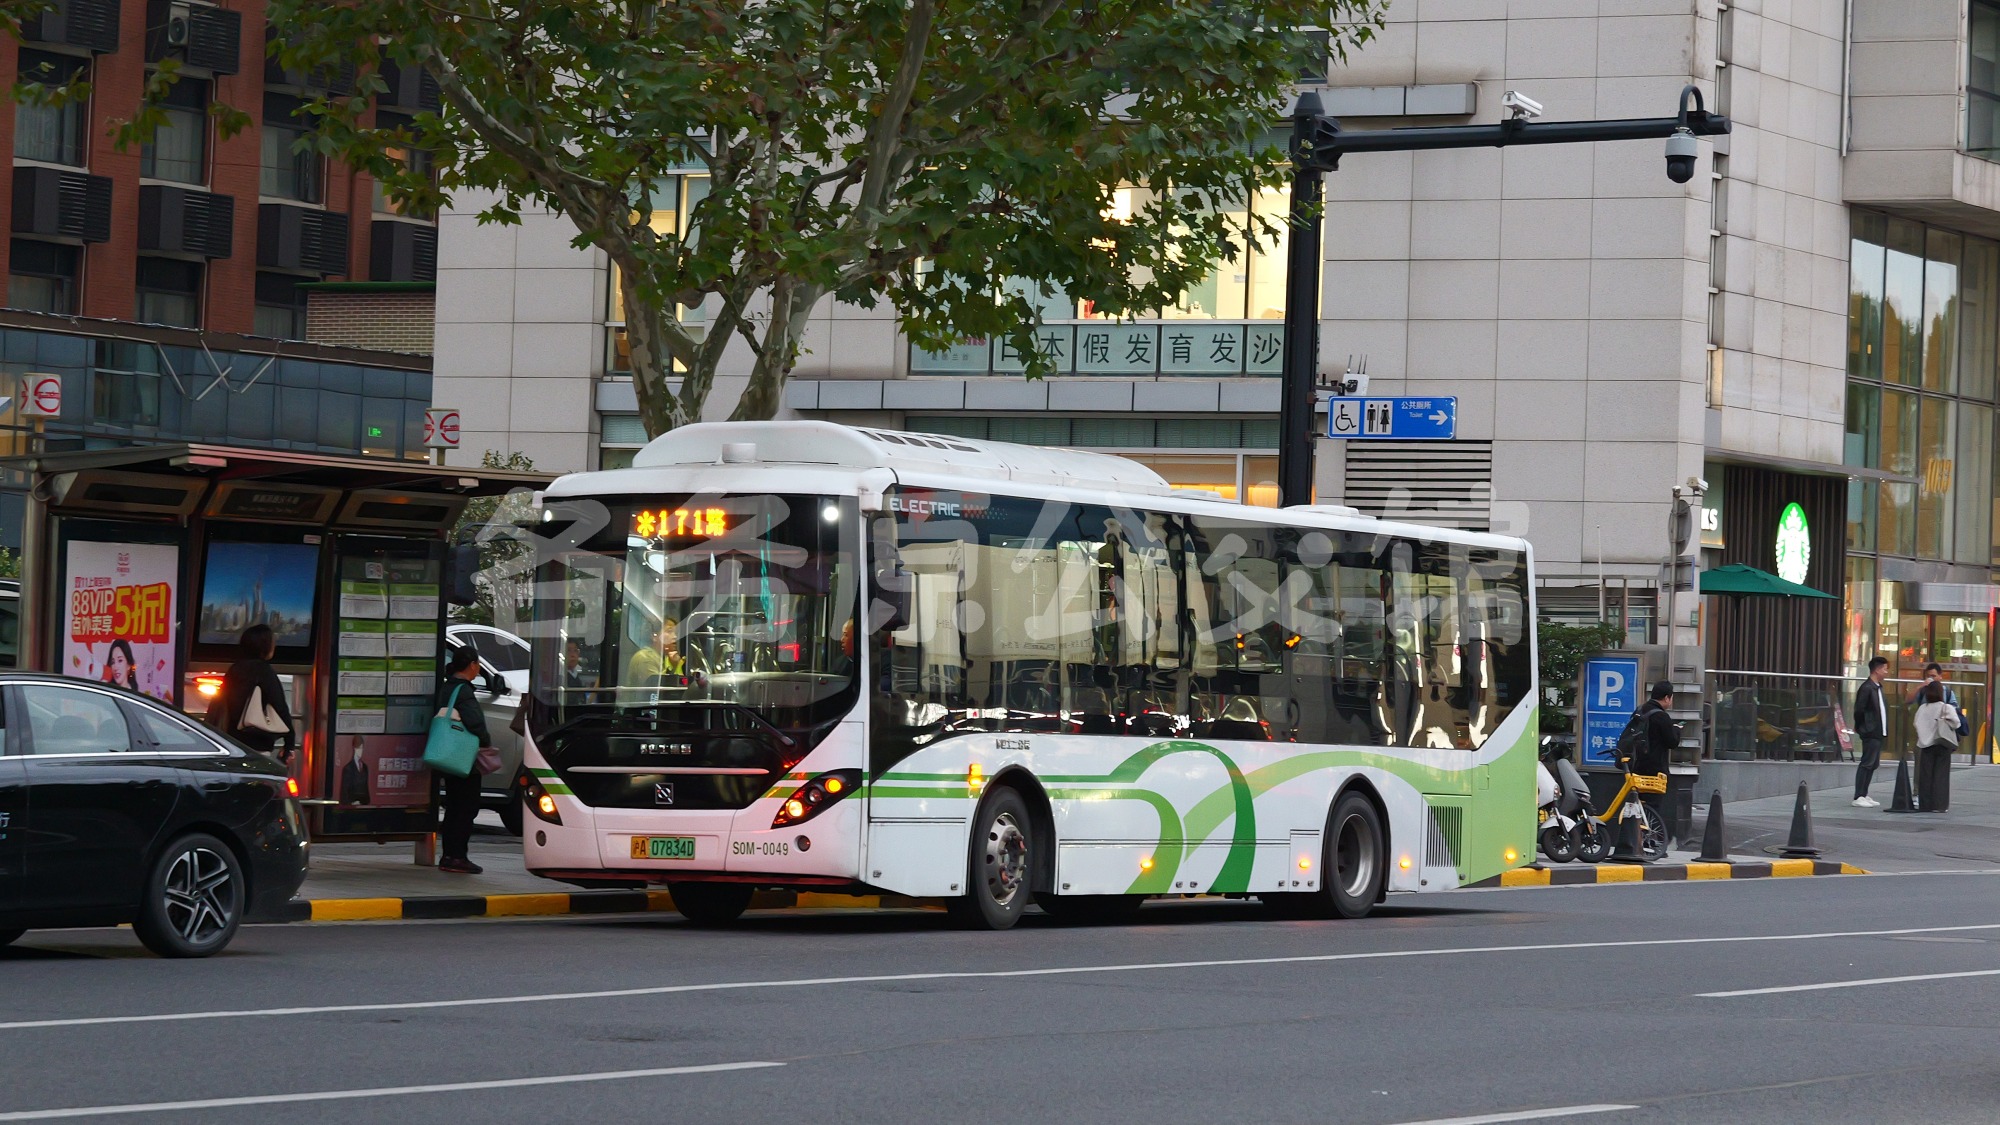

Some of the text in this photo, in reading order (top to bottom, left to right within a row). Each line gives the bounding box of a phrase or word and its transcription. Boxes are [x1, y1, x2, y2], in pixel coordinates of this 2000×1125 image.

[1001, 332, 1320, 364] 日本假发育发沙
[890, 498, 960, 517] ELECTRIC
[72, 589, 115, 616] 88VIP
[72, 615, 113, 636] 点外卖享
[1598, 670, 1625, 706] P
[1589, 720, 1627, 729] 徐家汇国际大
[1591, 735, 1620, 749] 停车
